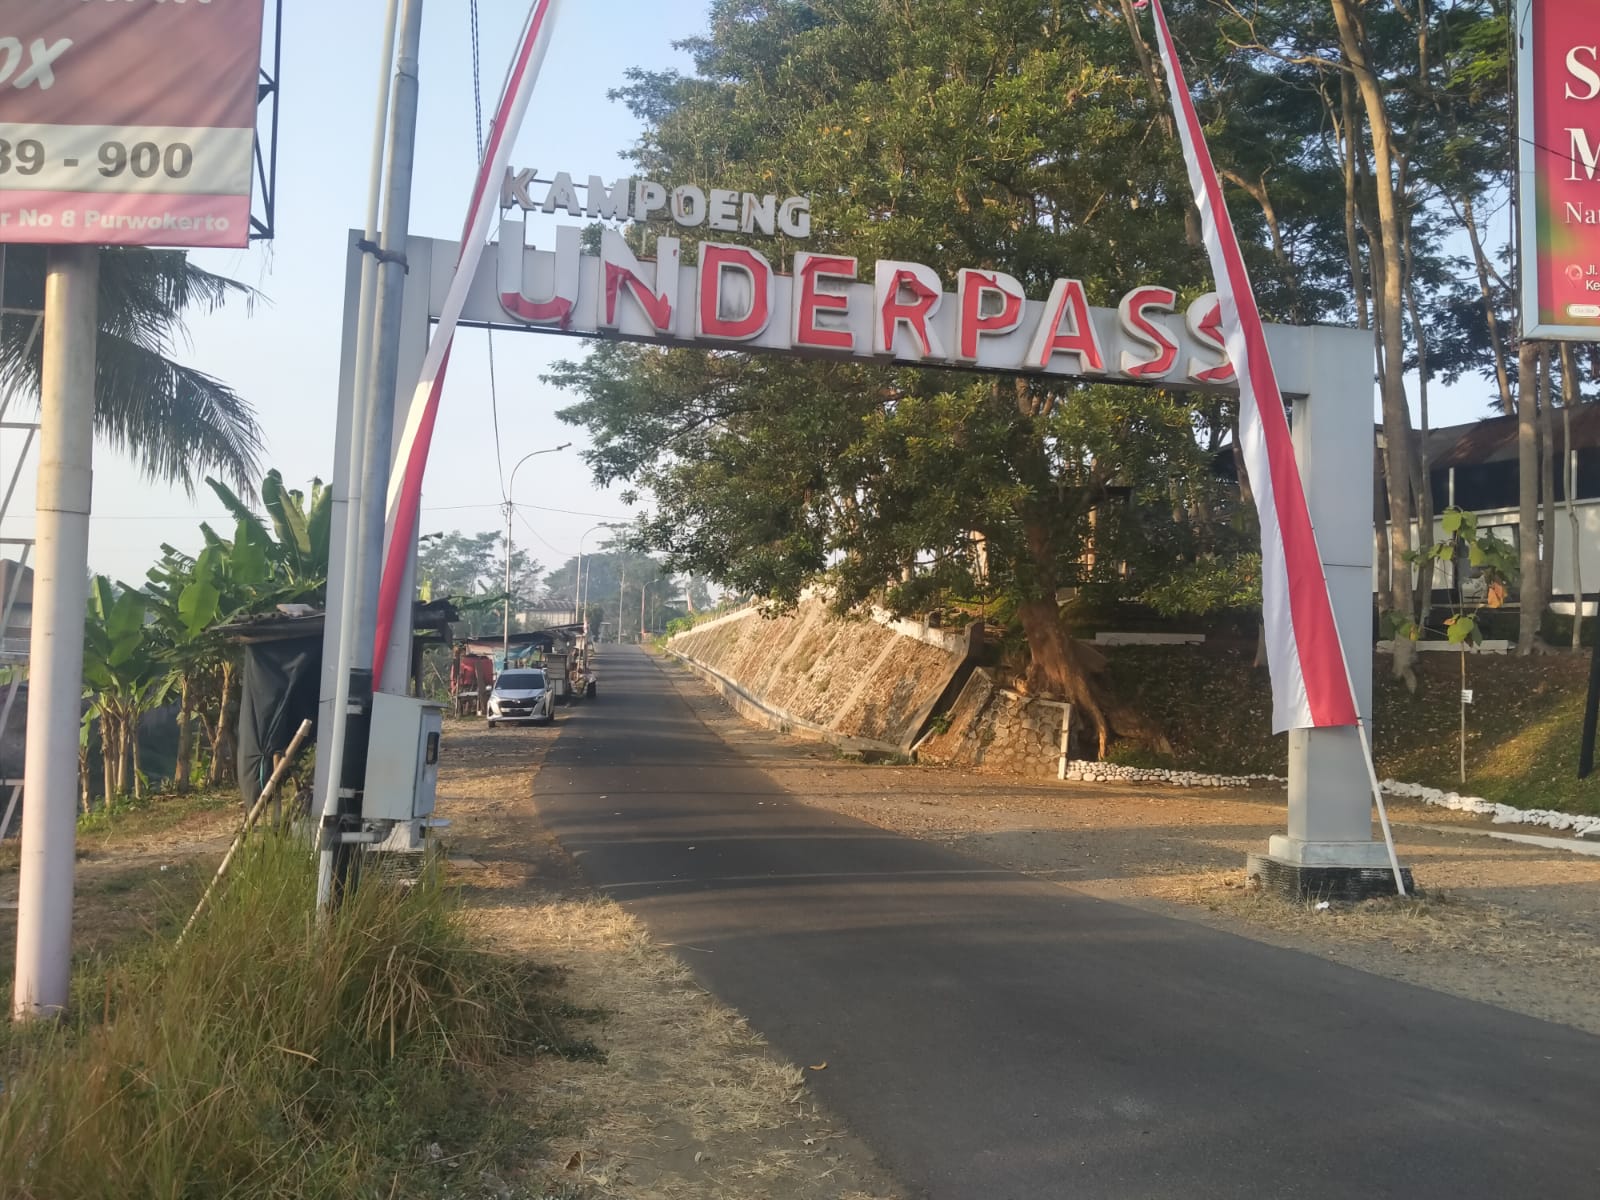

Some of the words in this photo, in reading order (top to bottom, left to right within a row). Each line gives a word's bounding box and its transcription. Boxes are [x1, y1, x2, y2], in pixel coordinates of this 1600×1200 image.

[97, 141, 193, 179] 900
[18, 208, 53, 228] No
[60, 209, 76, 228] 8
[84, 210, 230, 231] Purwokerto
[502, 166, 811, 238] KAMPOENG
[1564, 201, 1600, 224] Na
[496, 219, 1239, 385] UNDERPASS
